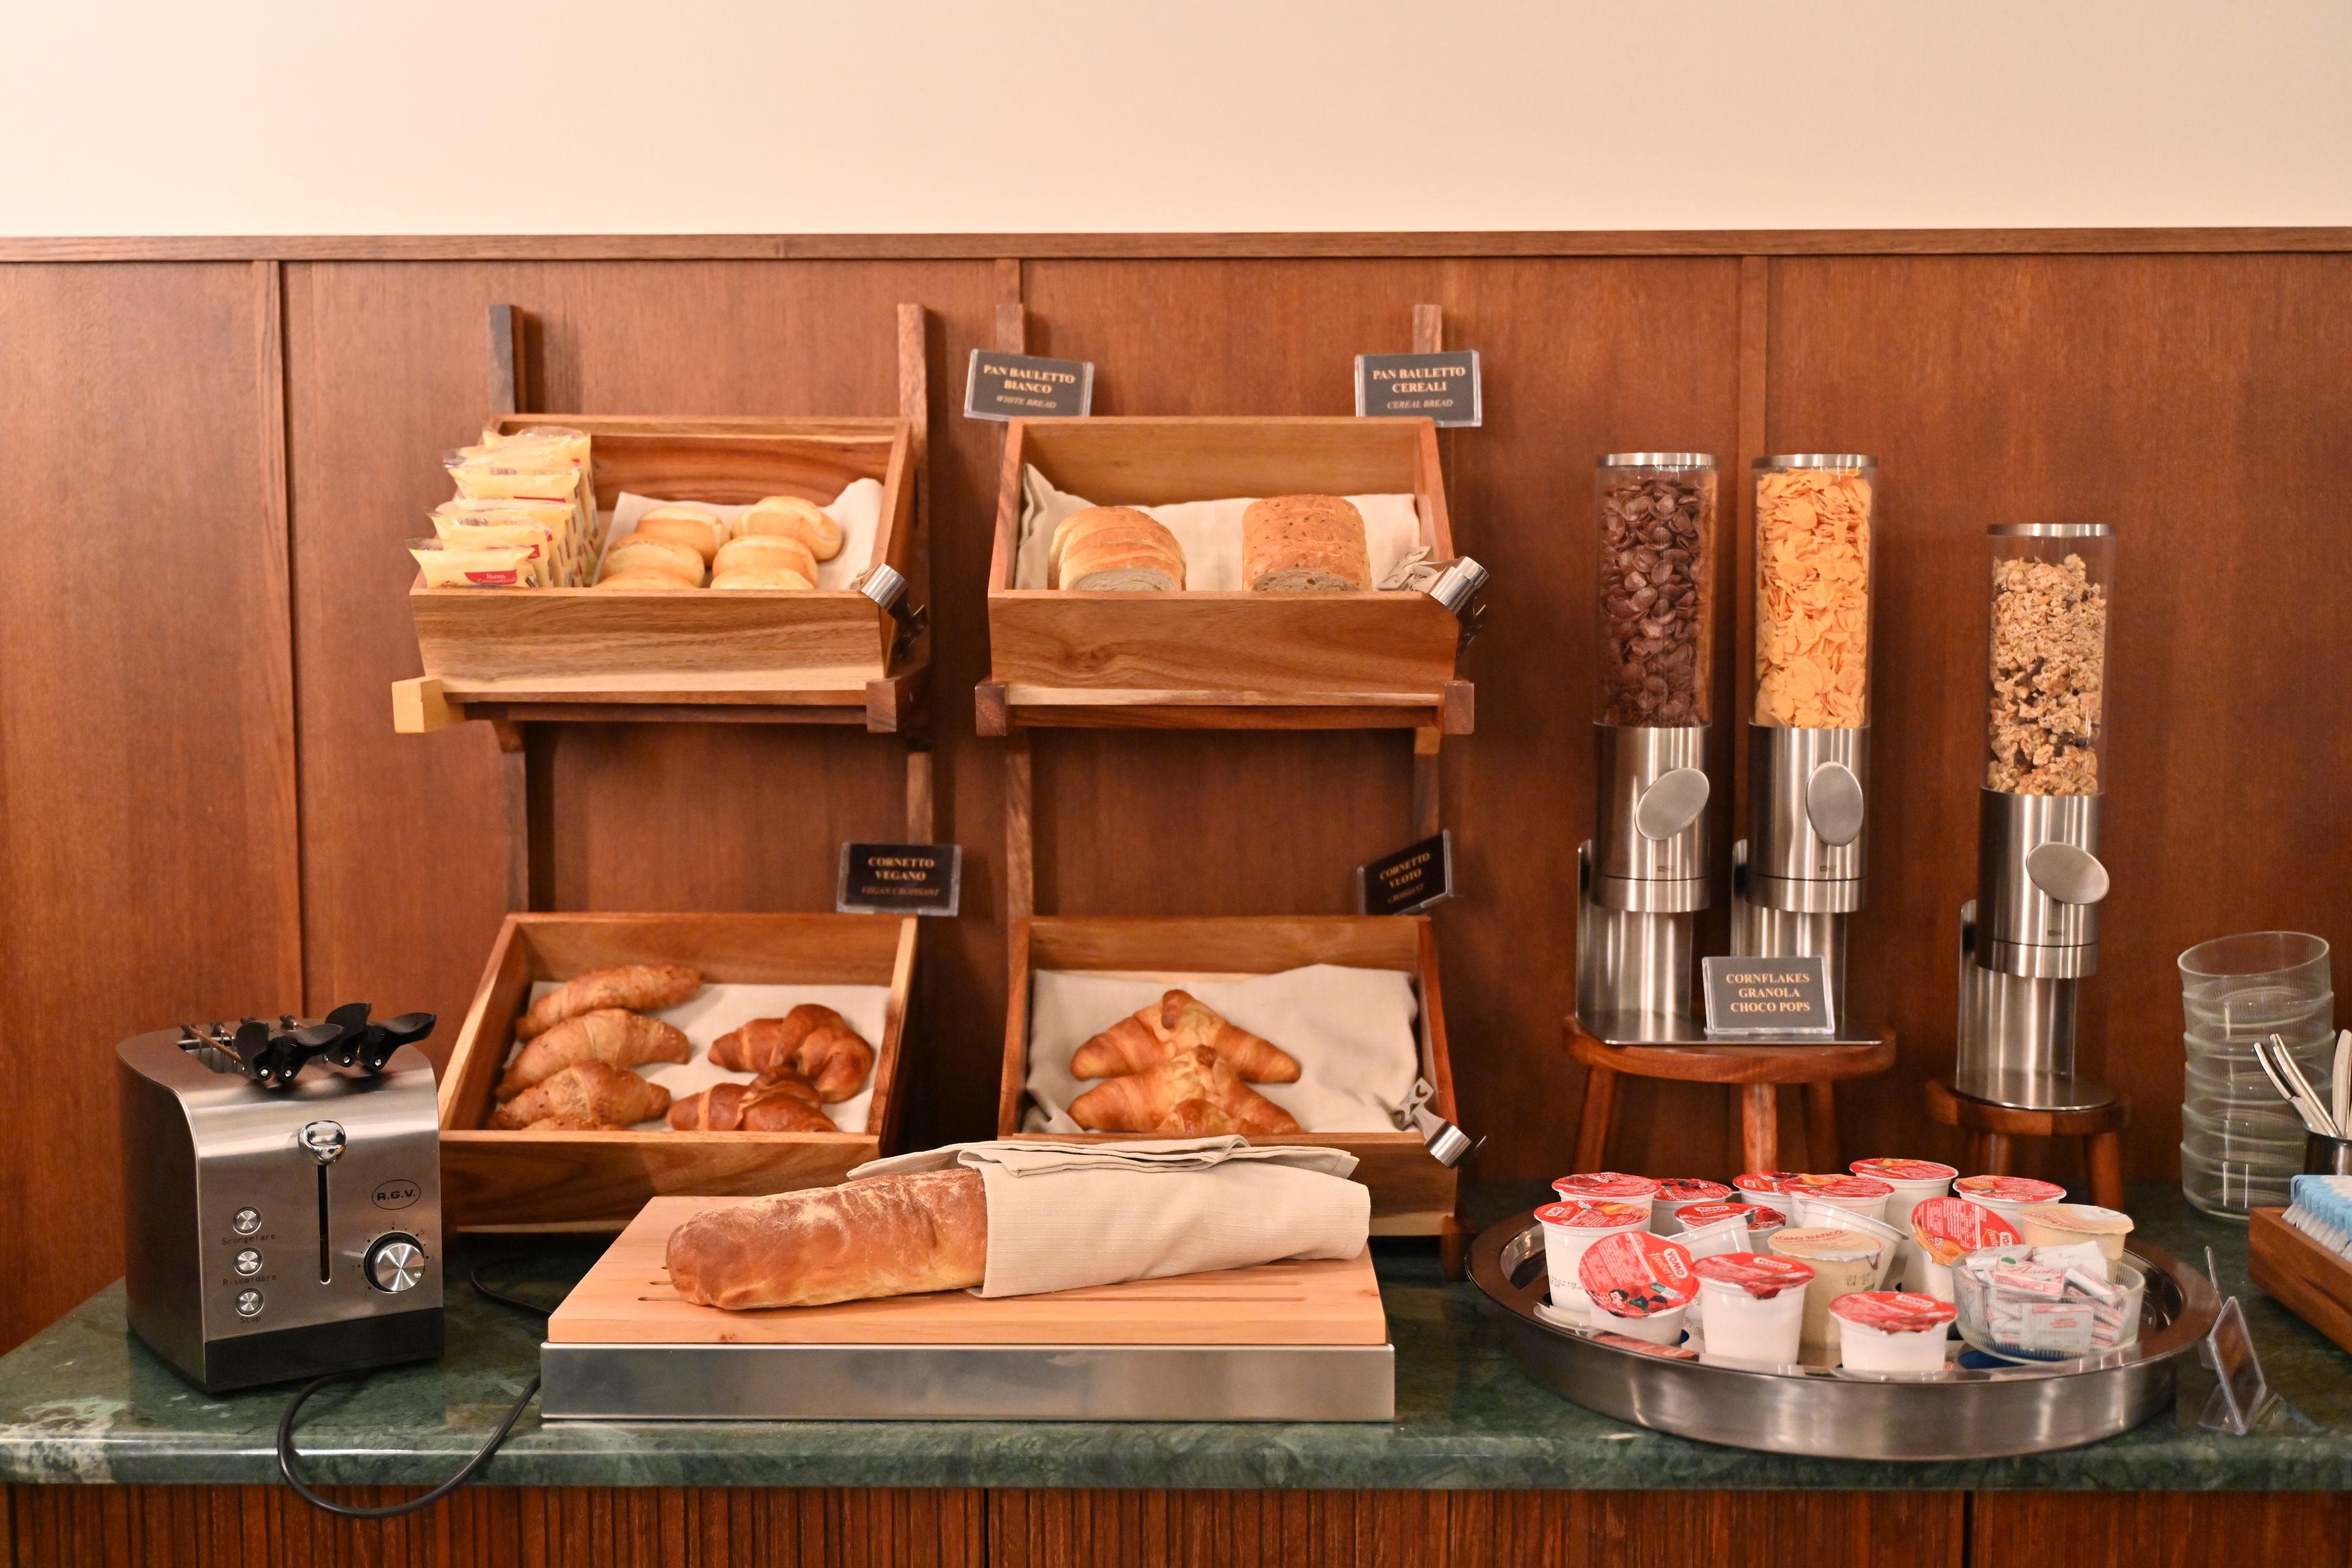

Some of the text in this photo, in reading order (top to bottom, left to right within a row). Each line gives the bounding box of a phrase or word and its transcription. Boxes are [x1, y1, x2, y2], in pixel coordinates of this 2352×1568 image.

[984, 364, 1076, 384] PAN BAULETTO
[1373, 366, 1466, 380] PAN BAULETTO
[1004, 380, 1053, 394] BIANCO
[1392, 381, 1448, 393] CEREALI
[1026, 399, 1057, 409] BREAD
[1387, 399, 1454, 410] CEREAL BREAD
[868, 856, 935, 869] CORNETTO
[1379, 852, 1431, 880] CORNETTO
[875, 870, 927, 881] VEGANO
[1389, 869, 1422, 888] VUOTO
[1725, 973, 1811, 984] CORNFLAKES
[1738, 987, 1801, 998] GRANOLA
[1730, 1001, 1811, 1012] CHOCO POPS
[377, 1189, 416, 1200] R.G.V.
[222, 1233, 276, 1245] Scongelare
[1805, 1230, 1844, 1240] BIANCO
[1667, 1251, 1684, 1276] YOMO
[1646, 1253, 1681, 1287] foodservice
[222, 1275, 277, 1286] Riscaldare
[1901, 1295, 1931, 1306] YOMO
